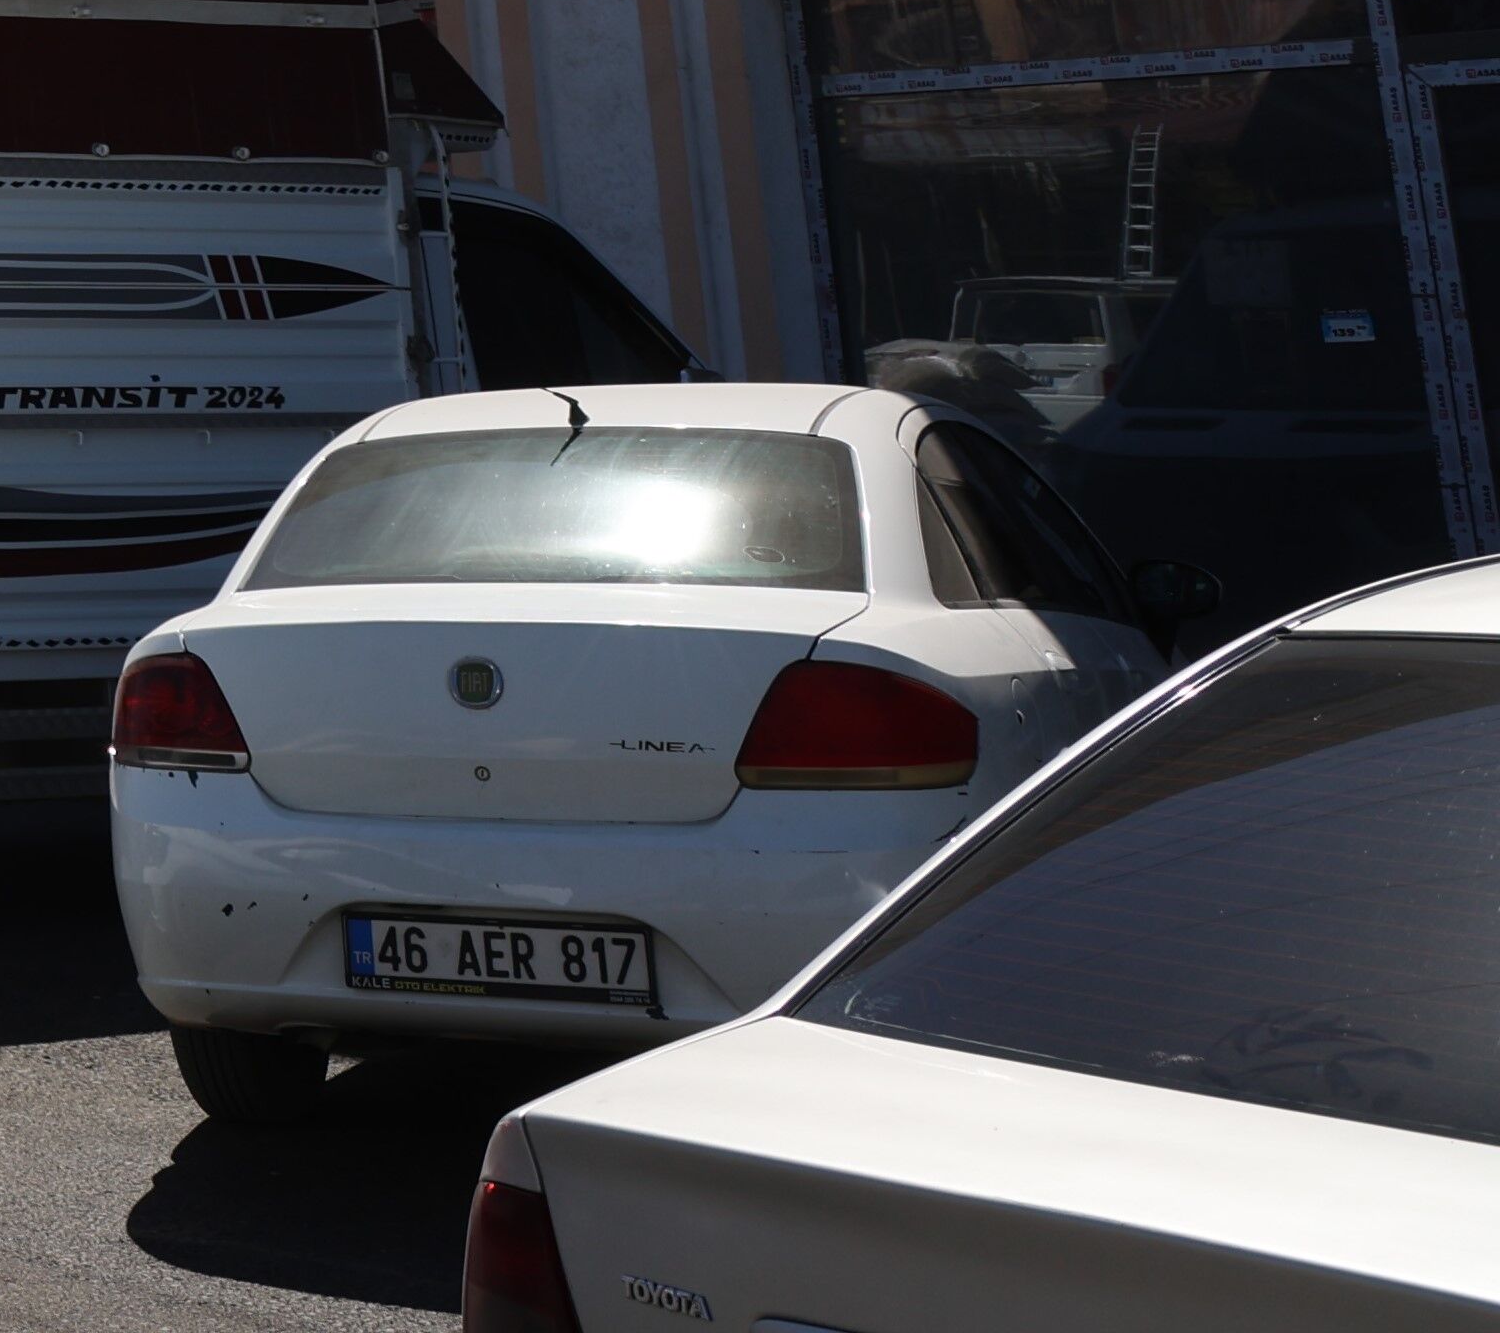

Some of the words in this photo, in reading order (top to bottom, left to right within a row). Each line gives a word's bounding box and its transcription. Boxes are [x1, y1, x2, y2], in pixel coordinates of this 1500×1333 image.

[203, 384, 287, 410] 2024
[459, 671, 490, 694] FIAT
[615, 739, 711, 754] LINEA
[353, 950, 373, 964] TR
[378, 926, 428, 974] 46
[457, 930, 536, 981] AER
[561, 935, 636, 985] 817
[351, 975, 391, 990] KALE
[394, 980, 420, 992] OTO
[620, 1273, 713, 1322] TOYOTA
